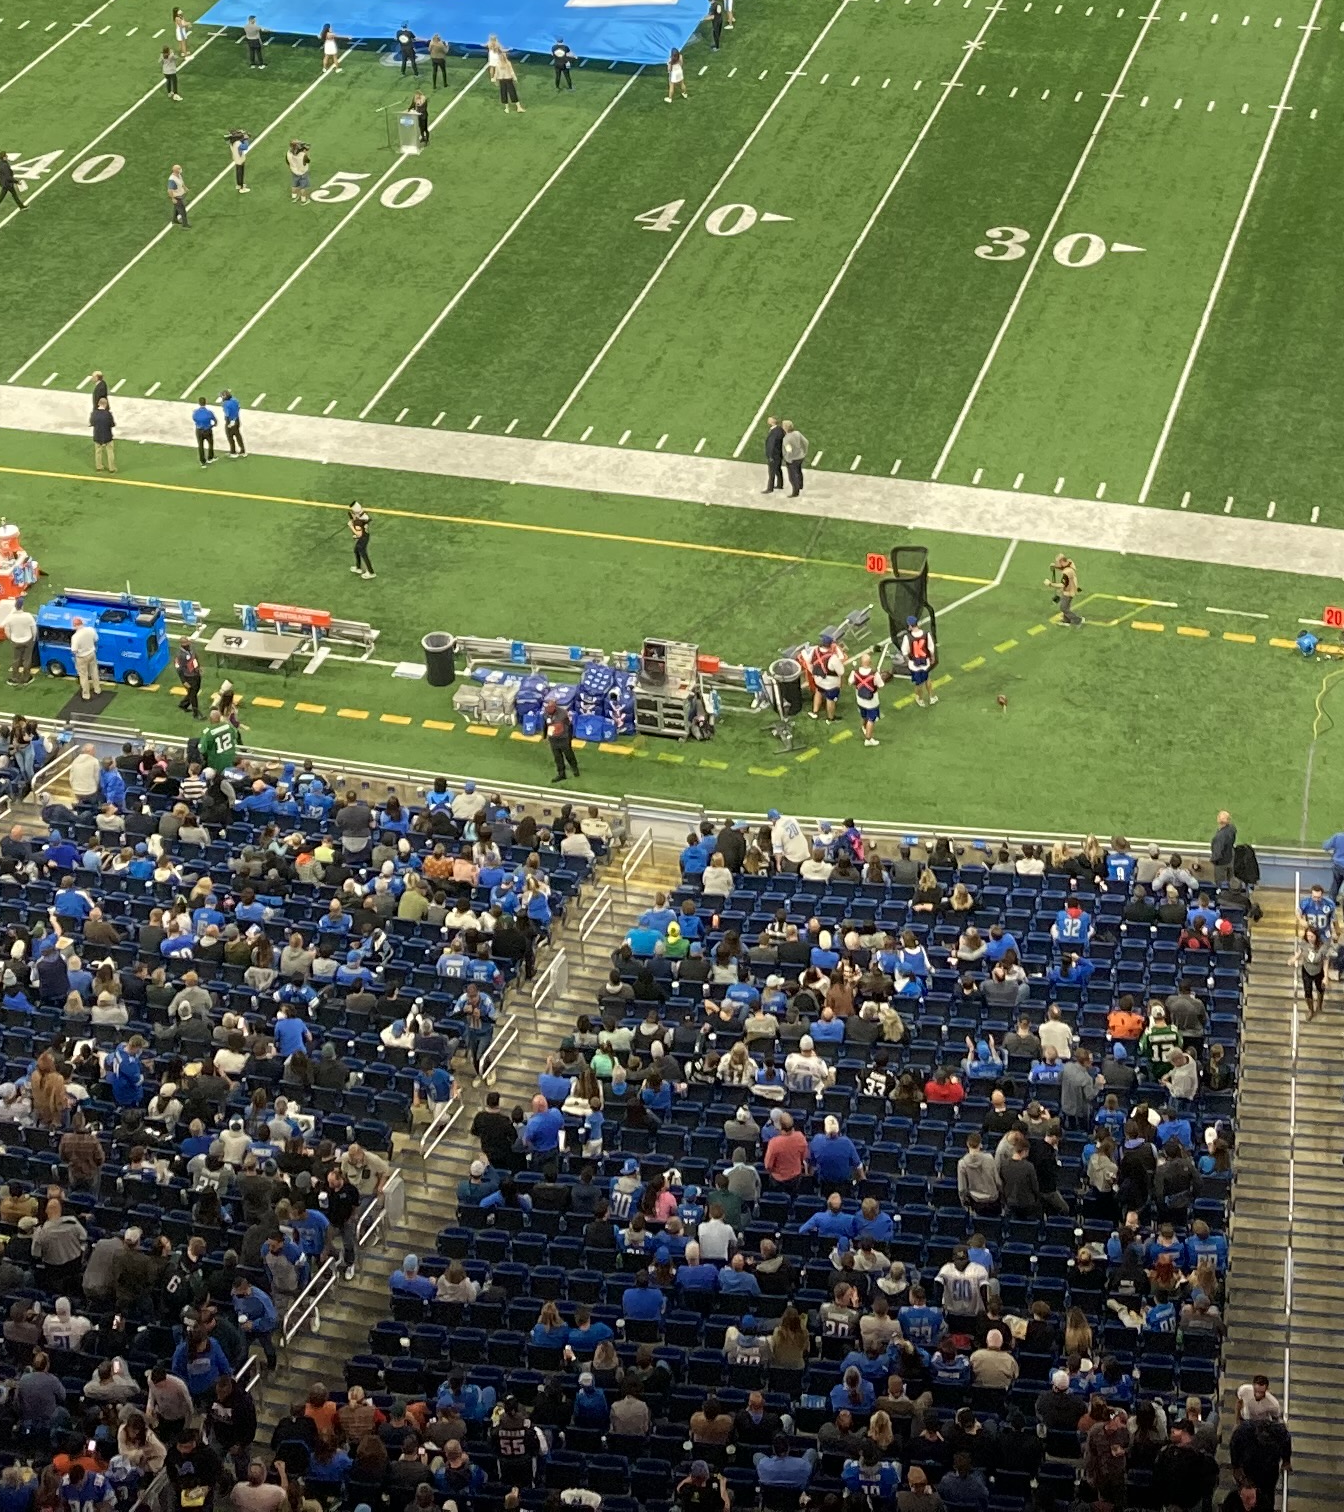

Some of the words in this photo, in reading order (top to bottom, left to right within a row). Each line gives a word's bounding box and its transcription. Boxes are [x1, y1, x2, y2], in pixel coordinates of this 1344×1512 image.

[6, 149, 126, 186] 40
[310, 170, 434, 210] 50
[632, 196, 758, 236] 40
[972, 225, 1108, 270] 30
[868, 555, 884, 572] 30
[1326, 608, 1344, 626] 20
[912, 638, 928, 659] K
[213, 732, 236, 754] 12
[785, 822, 800, 840] 20
[1062, 917, 1082, 938] 32
[863, 1078, 888, 1096] 33
[166, 1276, 182, 1294] 6
[500, 1437, 526, 1456] 55
